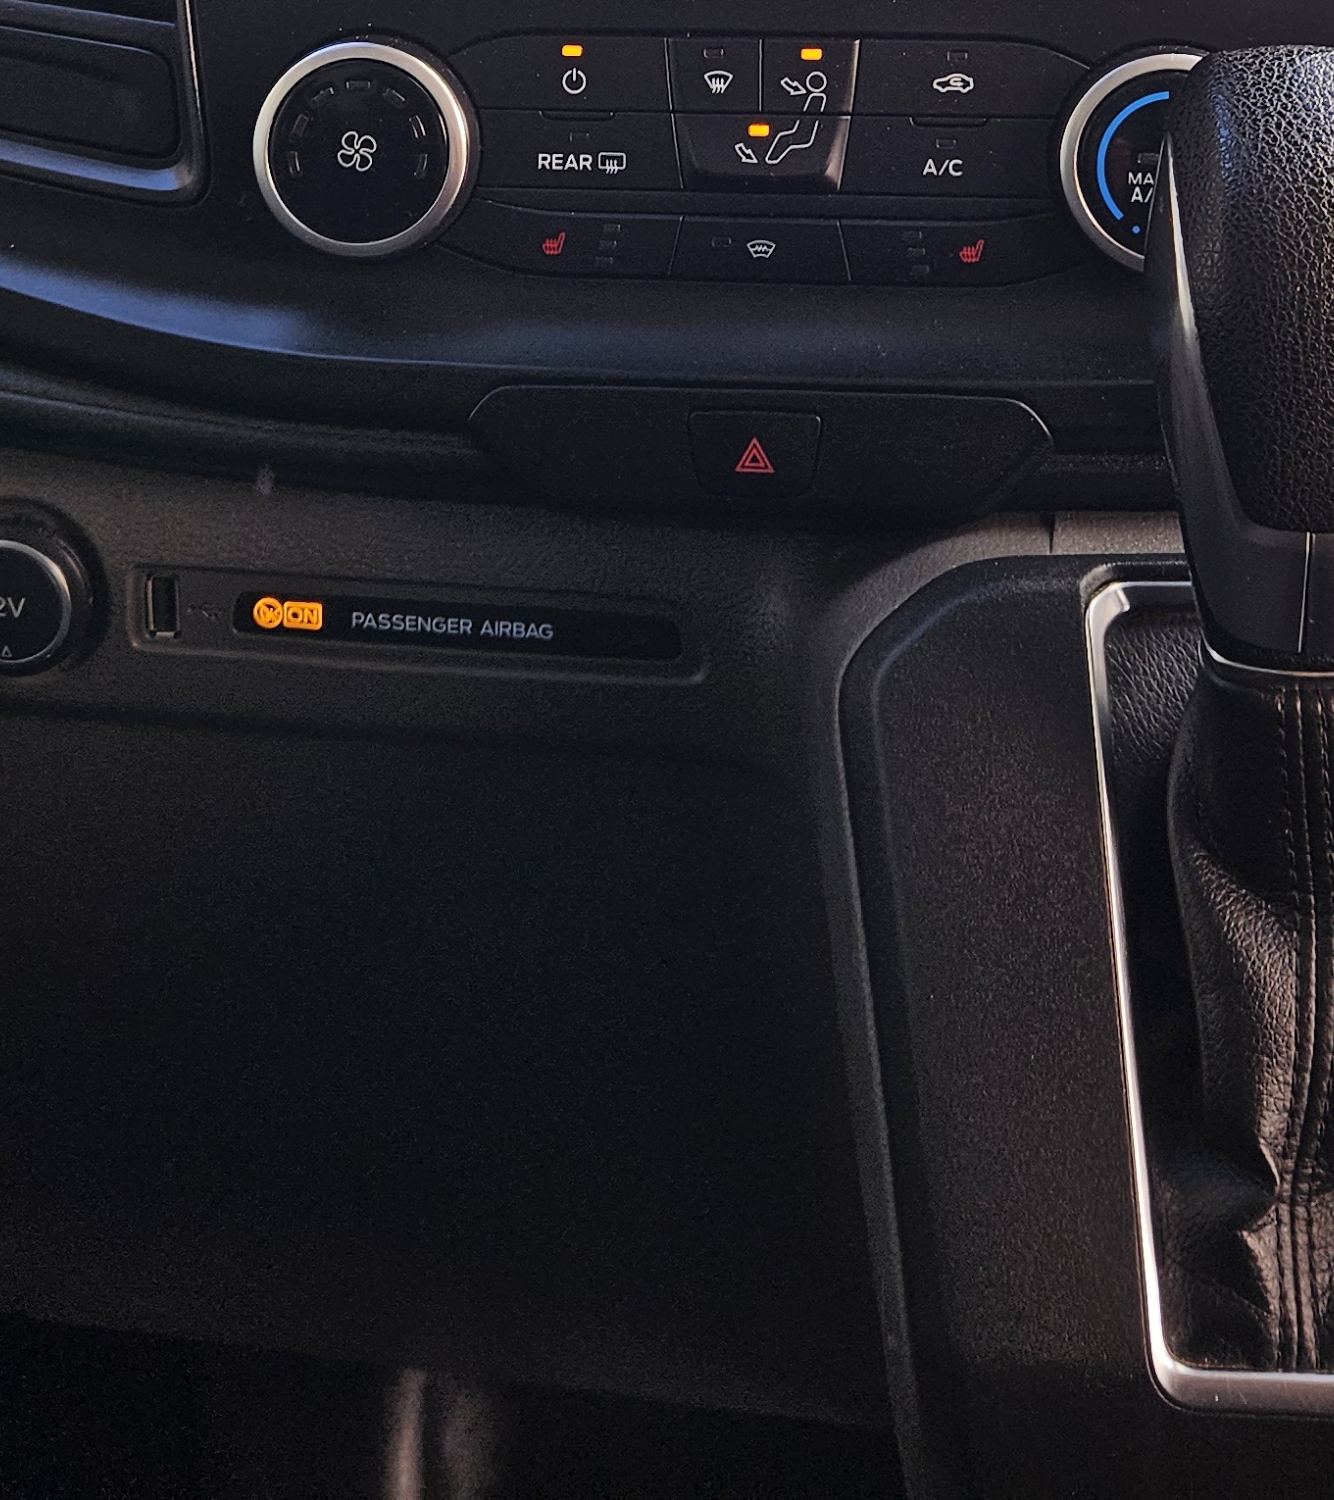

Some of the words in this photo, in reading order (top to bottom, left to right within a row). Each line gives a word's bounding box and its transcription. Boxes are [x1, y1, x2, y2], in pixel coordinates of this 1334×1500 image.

[538, 153, 592, 171] REAR
[923, 159, 964, 177] A/C
[1128, 171, 1155, 185] MA
[1130, 186, 1154, 203] A/
[351, 610, 473, 635] PASSENGER
[479, 619, 554, 640] AIRBAG
